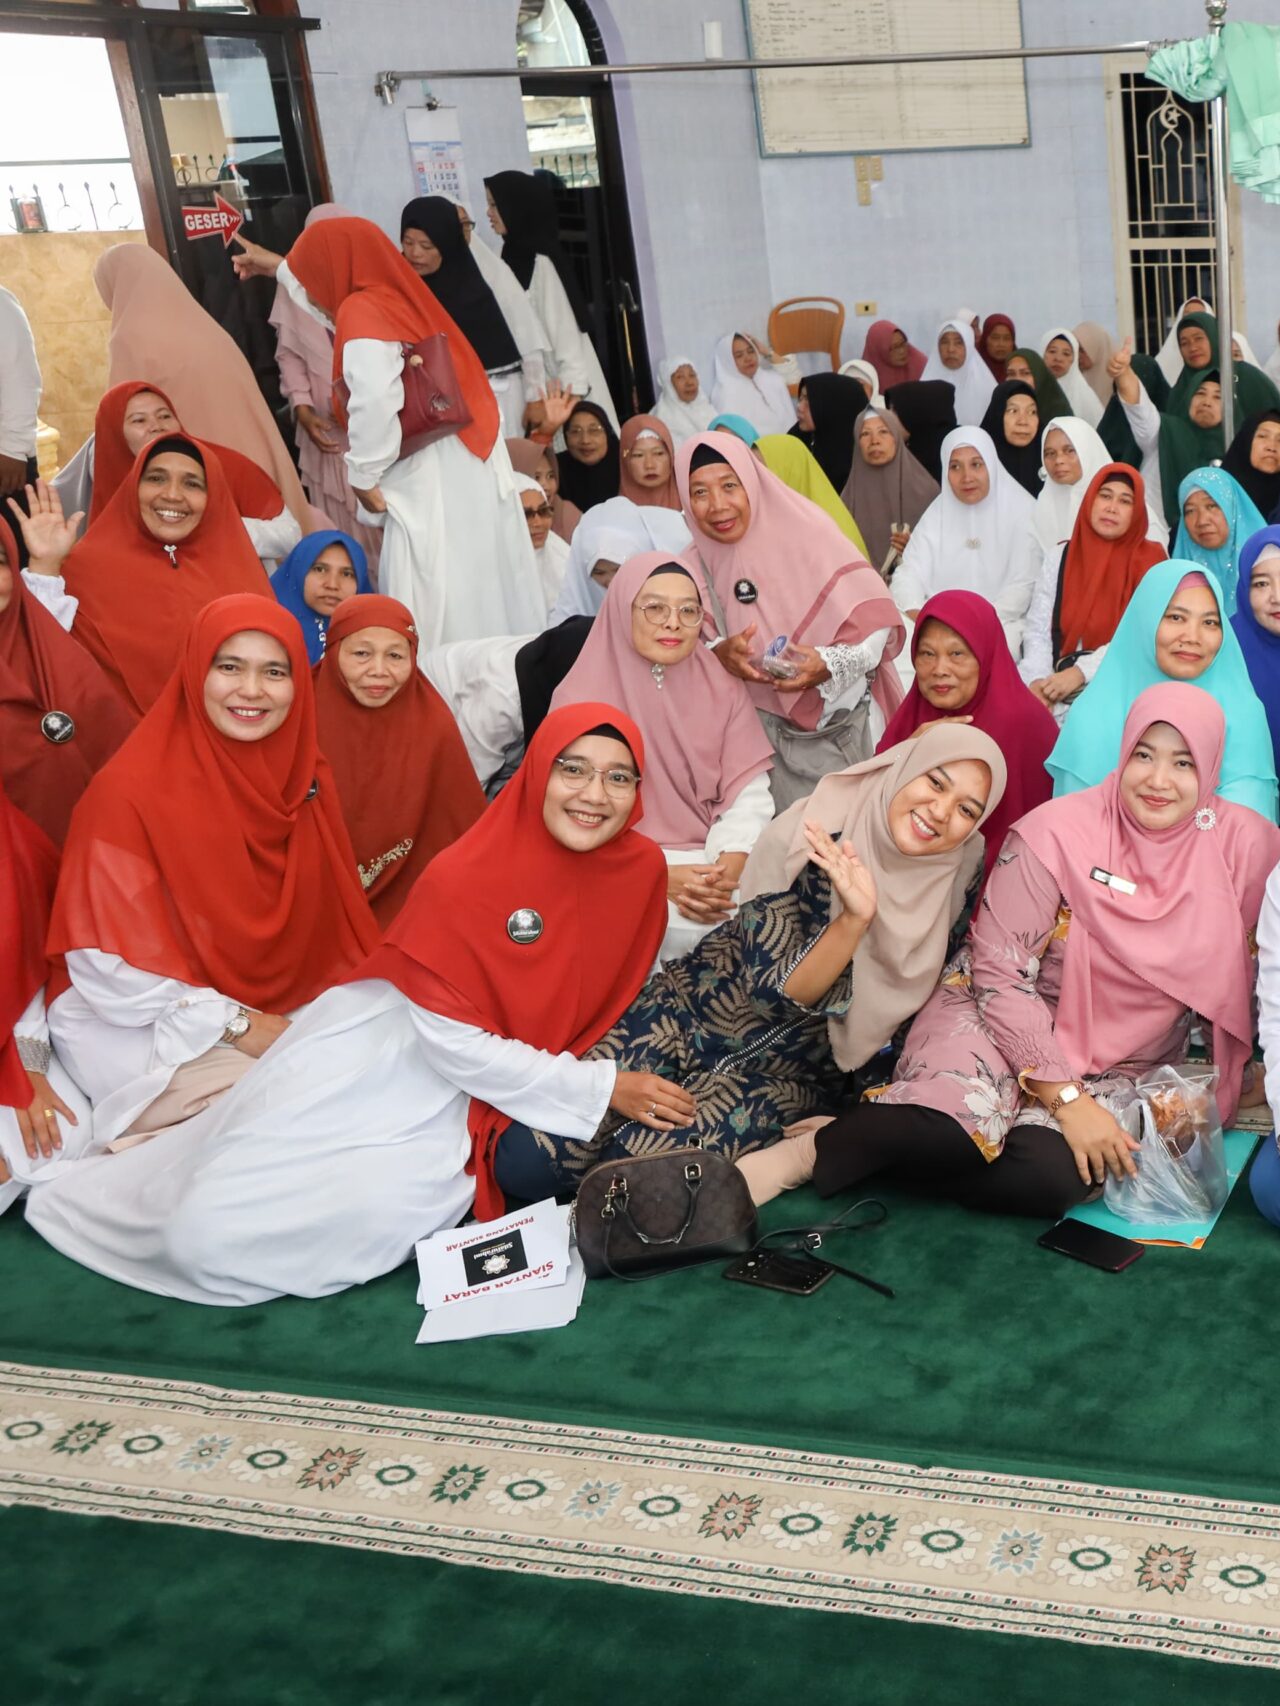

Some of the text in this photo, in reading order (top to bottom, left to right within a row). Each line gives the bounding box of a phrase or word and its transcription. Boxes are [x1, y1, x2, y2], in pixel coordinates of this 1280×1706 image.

[184, 212, 230, 231] GESER
[486, 1216, 534, 1237] PEMATANG
[446, 1235, 483, 1252] SIANTAR
[443, 1261, 553, 1302] SIANTAR BARAT
